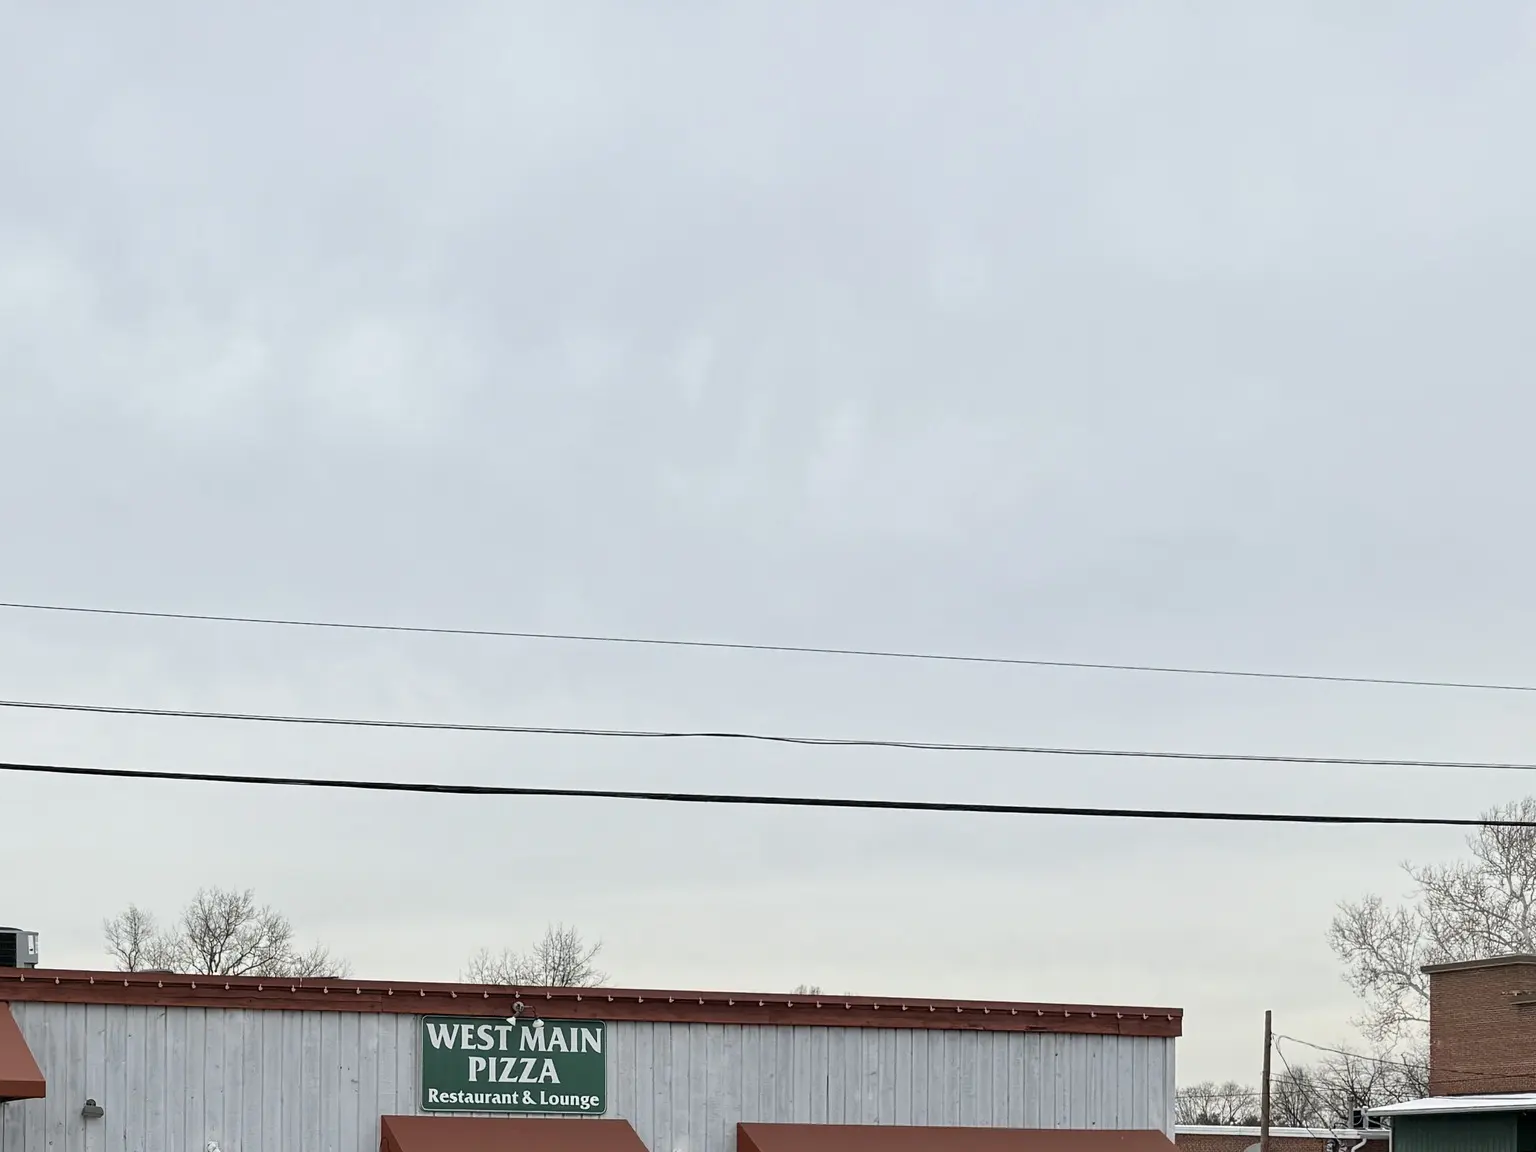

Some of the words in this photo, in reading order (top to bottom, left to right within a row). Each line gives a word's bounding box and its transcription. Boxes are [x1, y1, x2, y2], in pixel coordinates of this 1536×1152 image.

[426, 1023, 513, 1051] WEST
[519, 1025, 602, 1054] MAIN
[468, 1056, 561, 1084] PIZZA
[428, 1088, 519, 1105] Restaurant
[522, 1089, 537, 1105] &
[540, 1090, 600, 1110] Lounge
